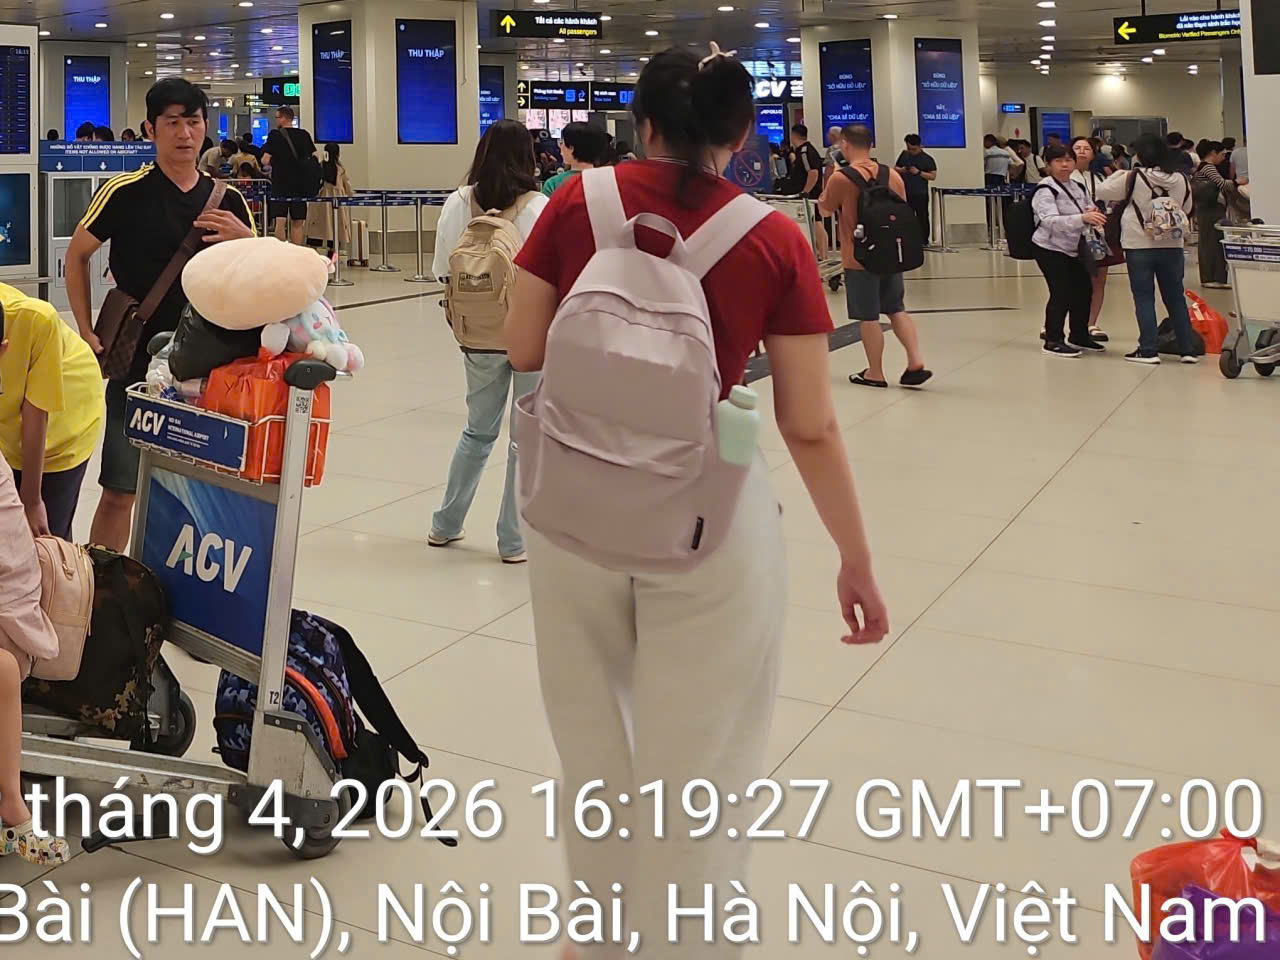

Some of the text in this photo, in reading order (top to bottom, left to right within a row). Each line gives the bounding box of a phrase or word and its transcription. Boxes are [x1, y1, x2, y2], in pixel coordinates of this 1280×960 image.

[559, 27, 598, 37] All passengers
[408, 49, 422, 58] THU
[129, 407, 166, 436] ACV
[165, 523, 253, 593] ACV
[269, 690, 280, 706] T2
